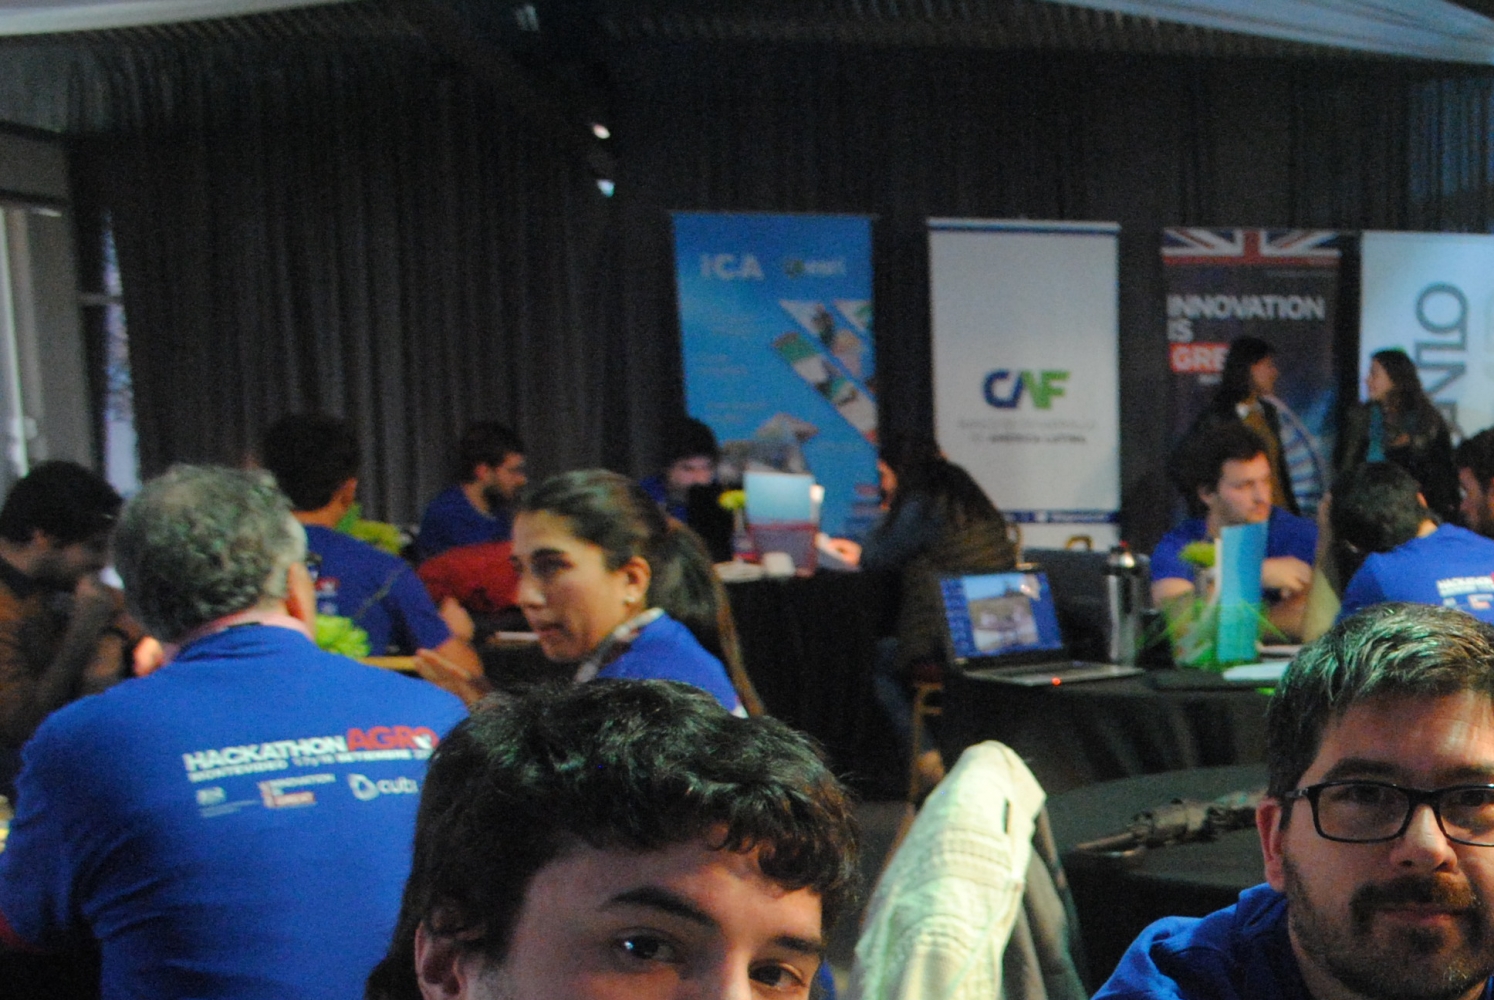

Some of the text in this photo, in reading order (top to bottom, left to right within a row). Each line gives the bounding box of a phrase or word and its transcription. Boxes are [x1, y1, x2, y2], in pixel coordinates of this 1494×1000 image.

[701, 254, 764, 280] ICA
[1167, 295, 1325, 320] INNOVATION
[1167, 318, 1193, 342] IS
[1172, 346, 1229, 371] GRE
[982, 369, 1071, 409] CAF
[182, 726, 440, 773] HACKATHON AGRO
